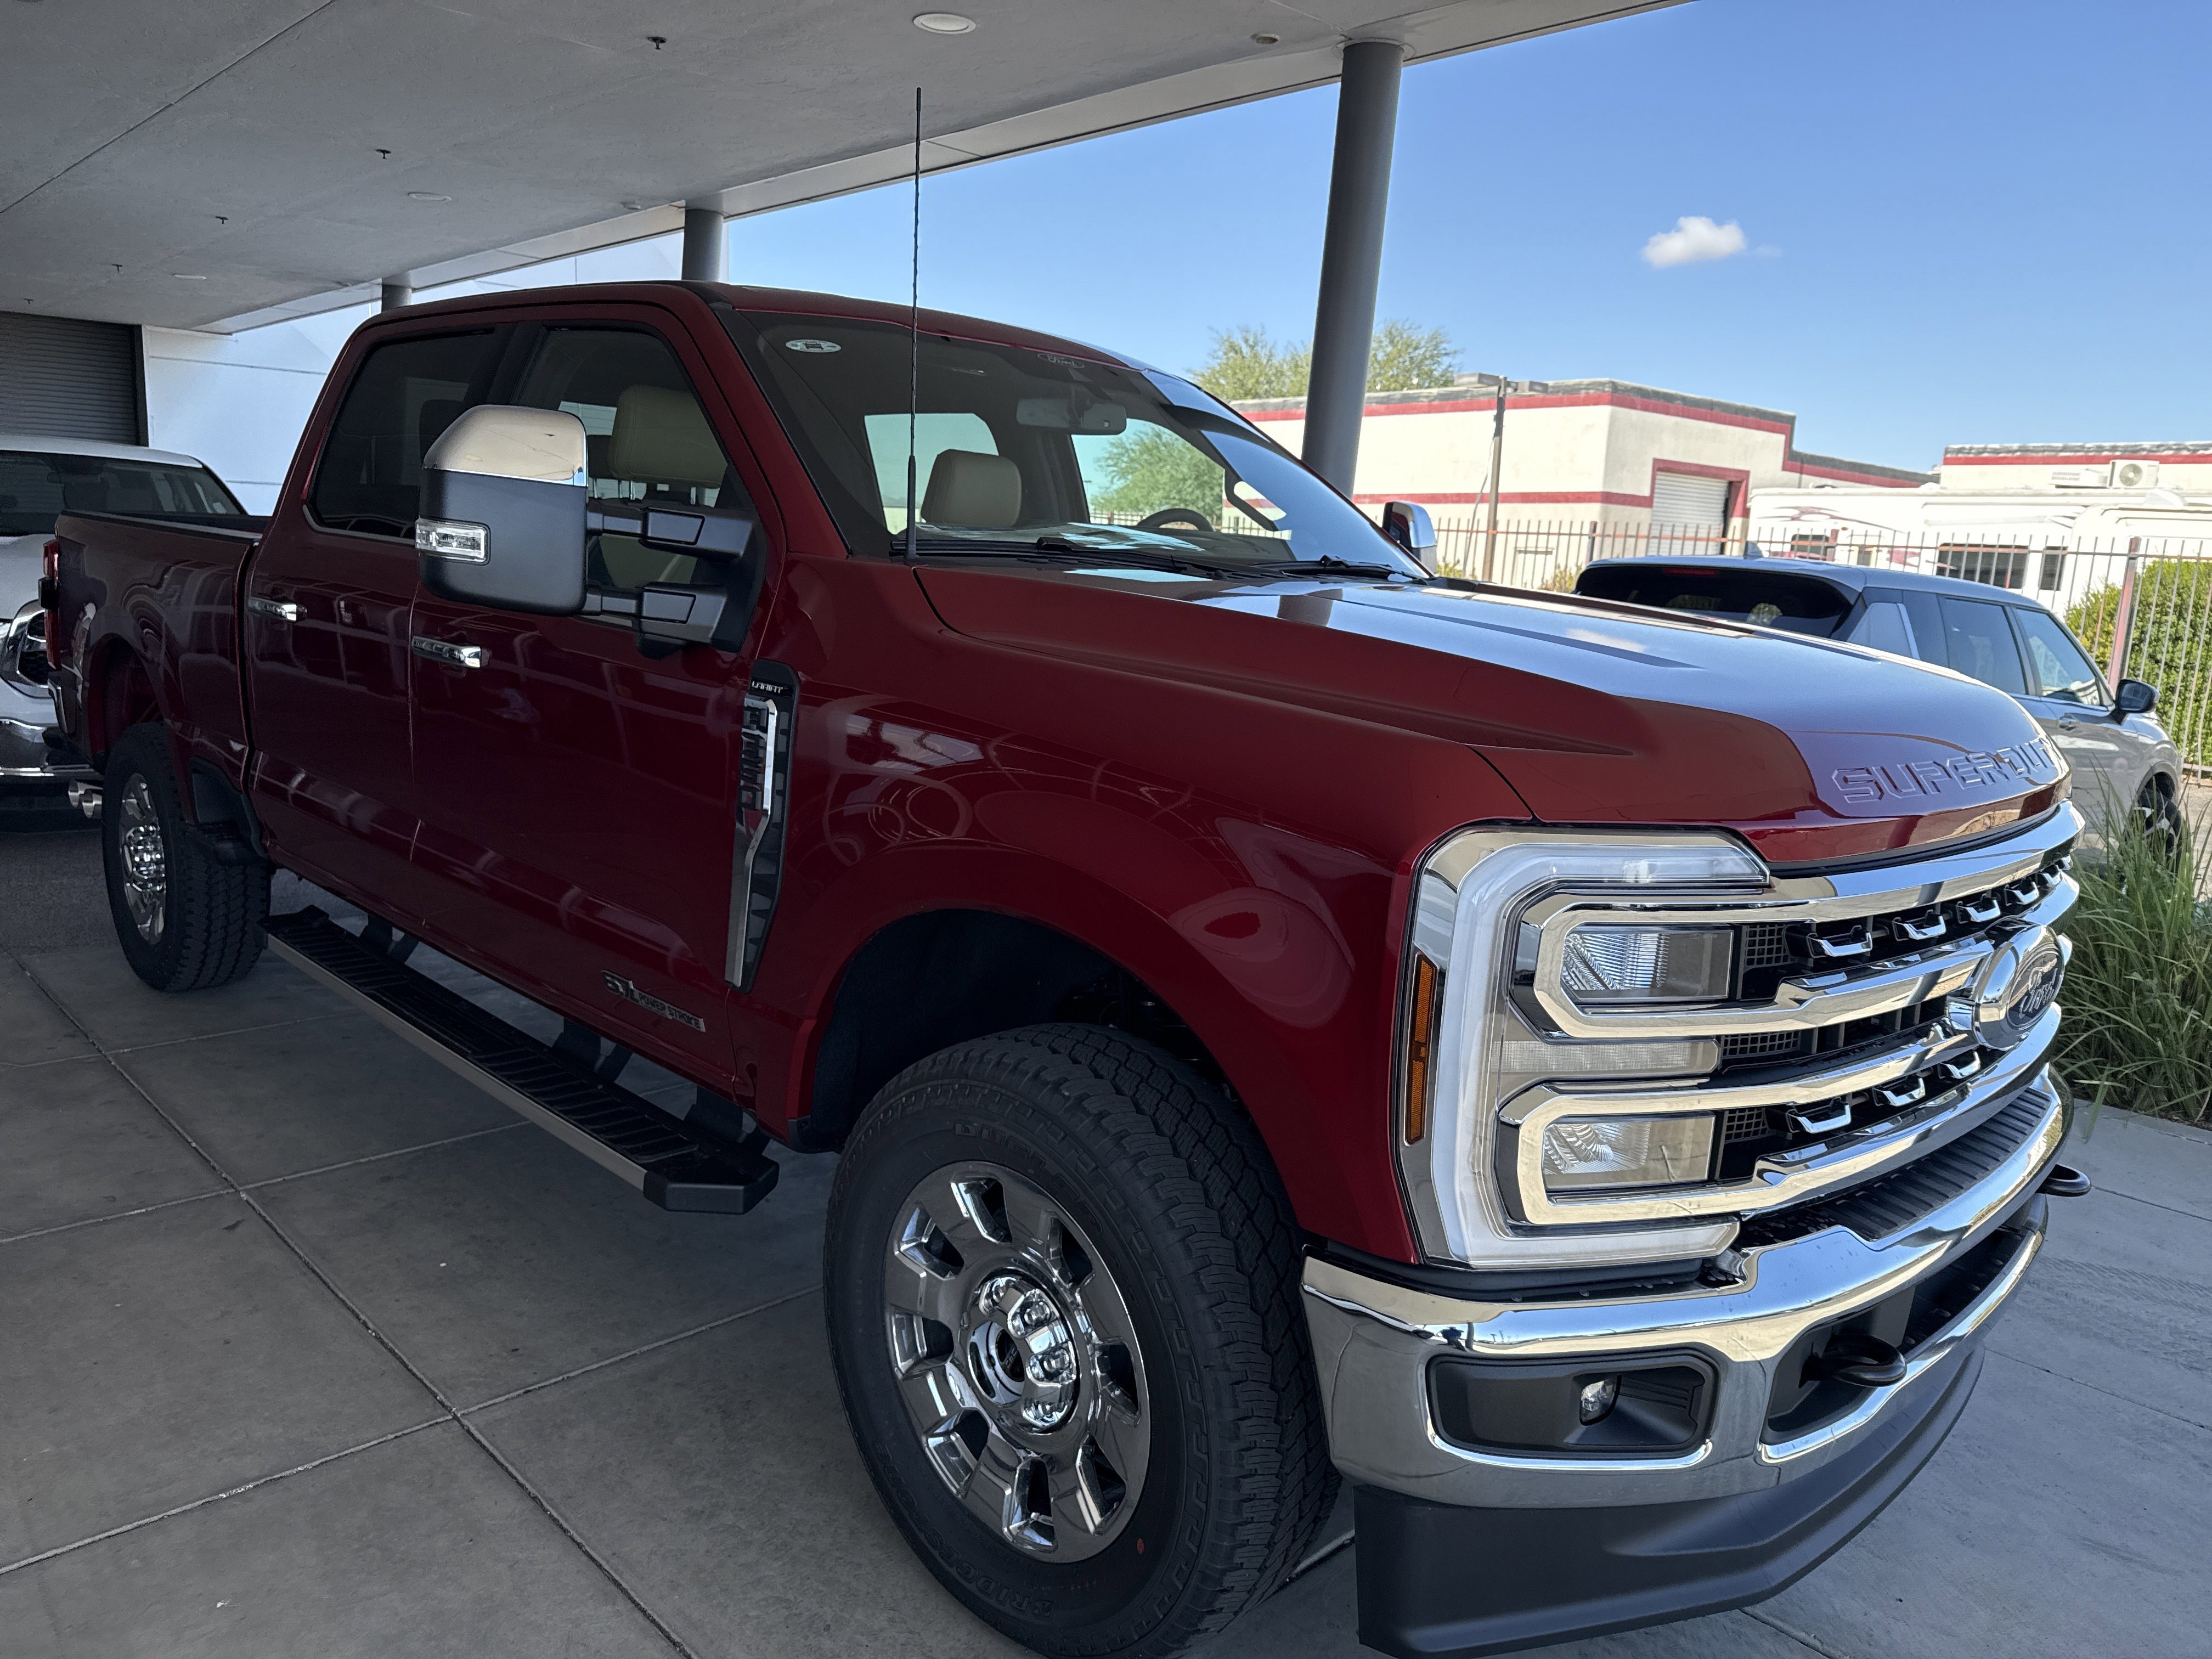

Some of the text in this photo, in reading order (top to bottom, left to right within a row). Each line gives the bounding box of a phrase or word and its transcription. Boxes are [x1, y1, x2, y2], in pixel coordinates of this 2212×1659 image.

[752, 681, 783, 693] LARIAT
[1832, 751, 2010, 803] SUPER
[2019, 967, 2058, 1019] Ford
[873, 1441, 1057, 1618] BRIDGESTONE
